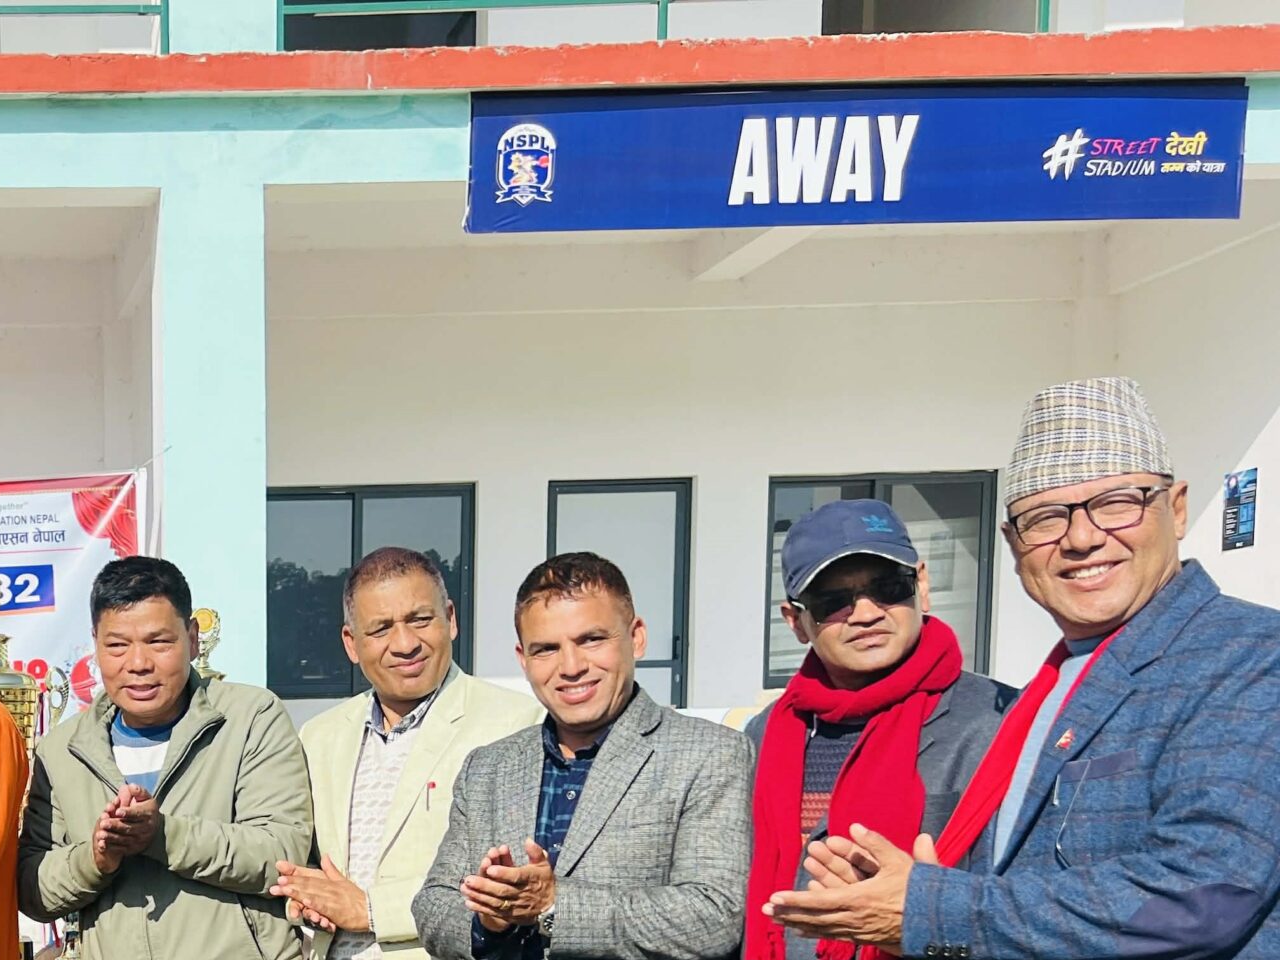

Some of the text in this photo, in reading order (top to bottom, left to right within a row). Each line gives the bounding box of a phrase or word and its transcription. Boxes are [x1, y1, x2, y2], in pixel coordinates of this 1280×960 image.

[504, 134, 550, 151] NSPL
[1090, 137, 1163, 156] STREET
[1165, 131, 1208, 156] देखी
[727, 115, 920, 205] AWAY
[1084, 159, 1156, 177] STADIUM
[1186, 160, 1202, 172] को
[1203, 162, 1226, 173] यात्रा
[30, 513, 60, 524] NEPAL
[33, 527, 66, 544] नेपाल
